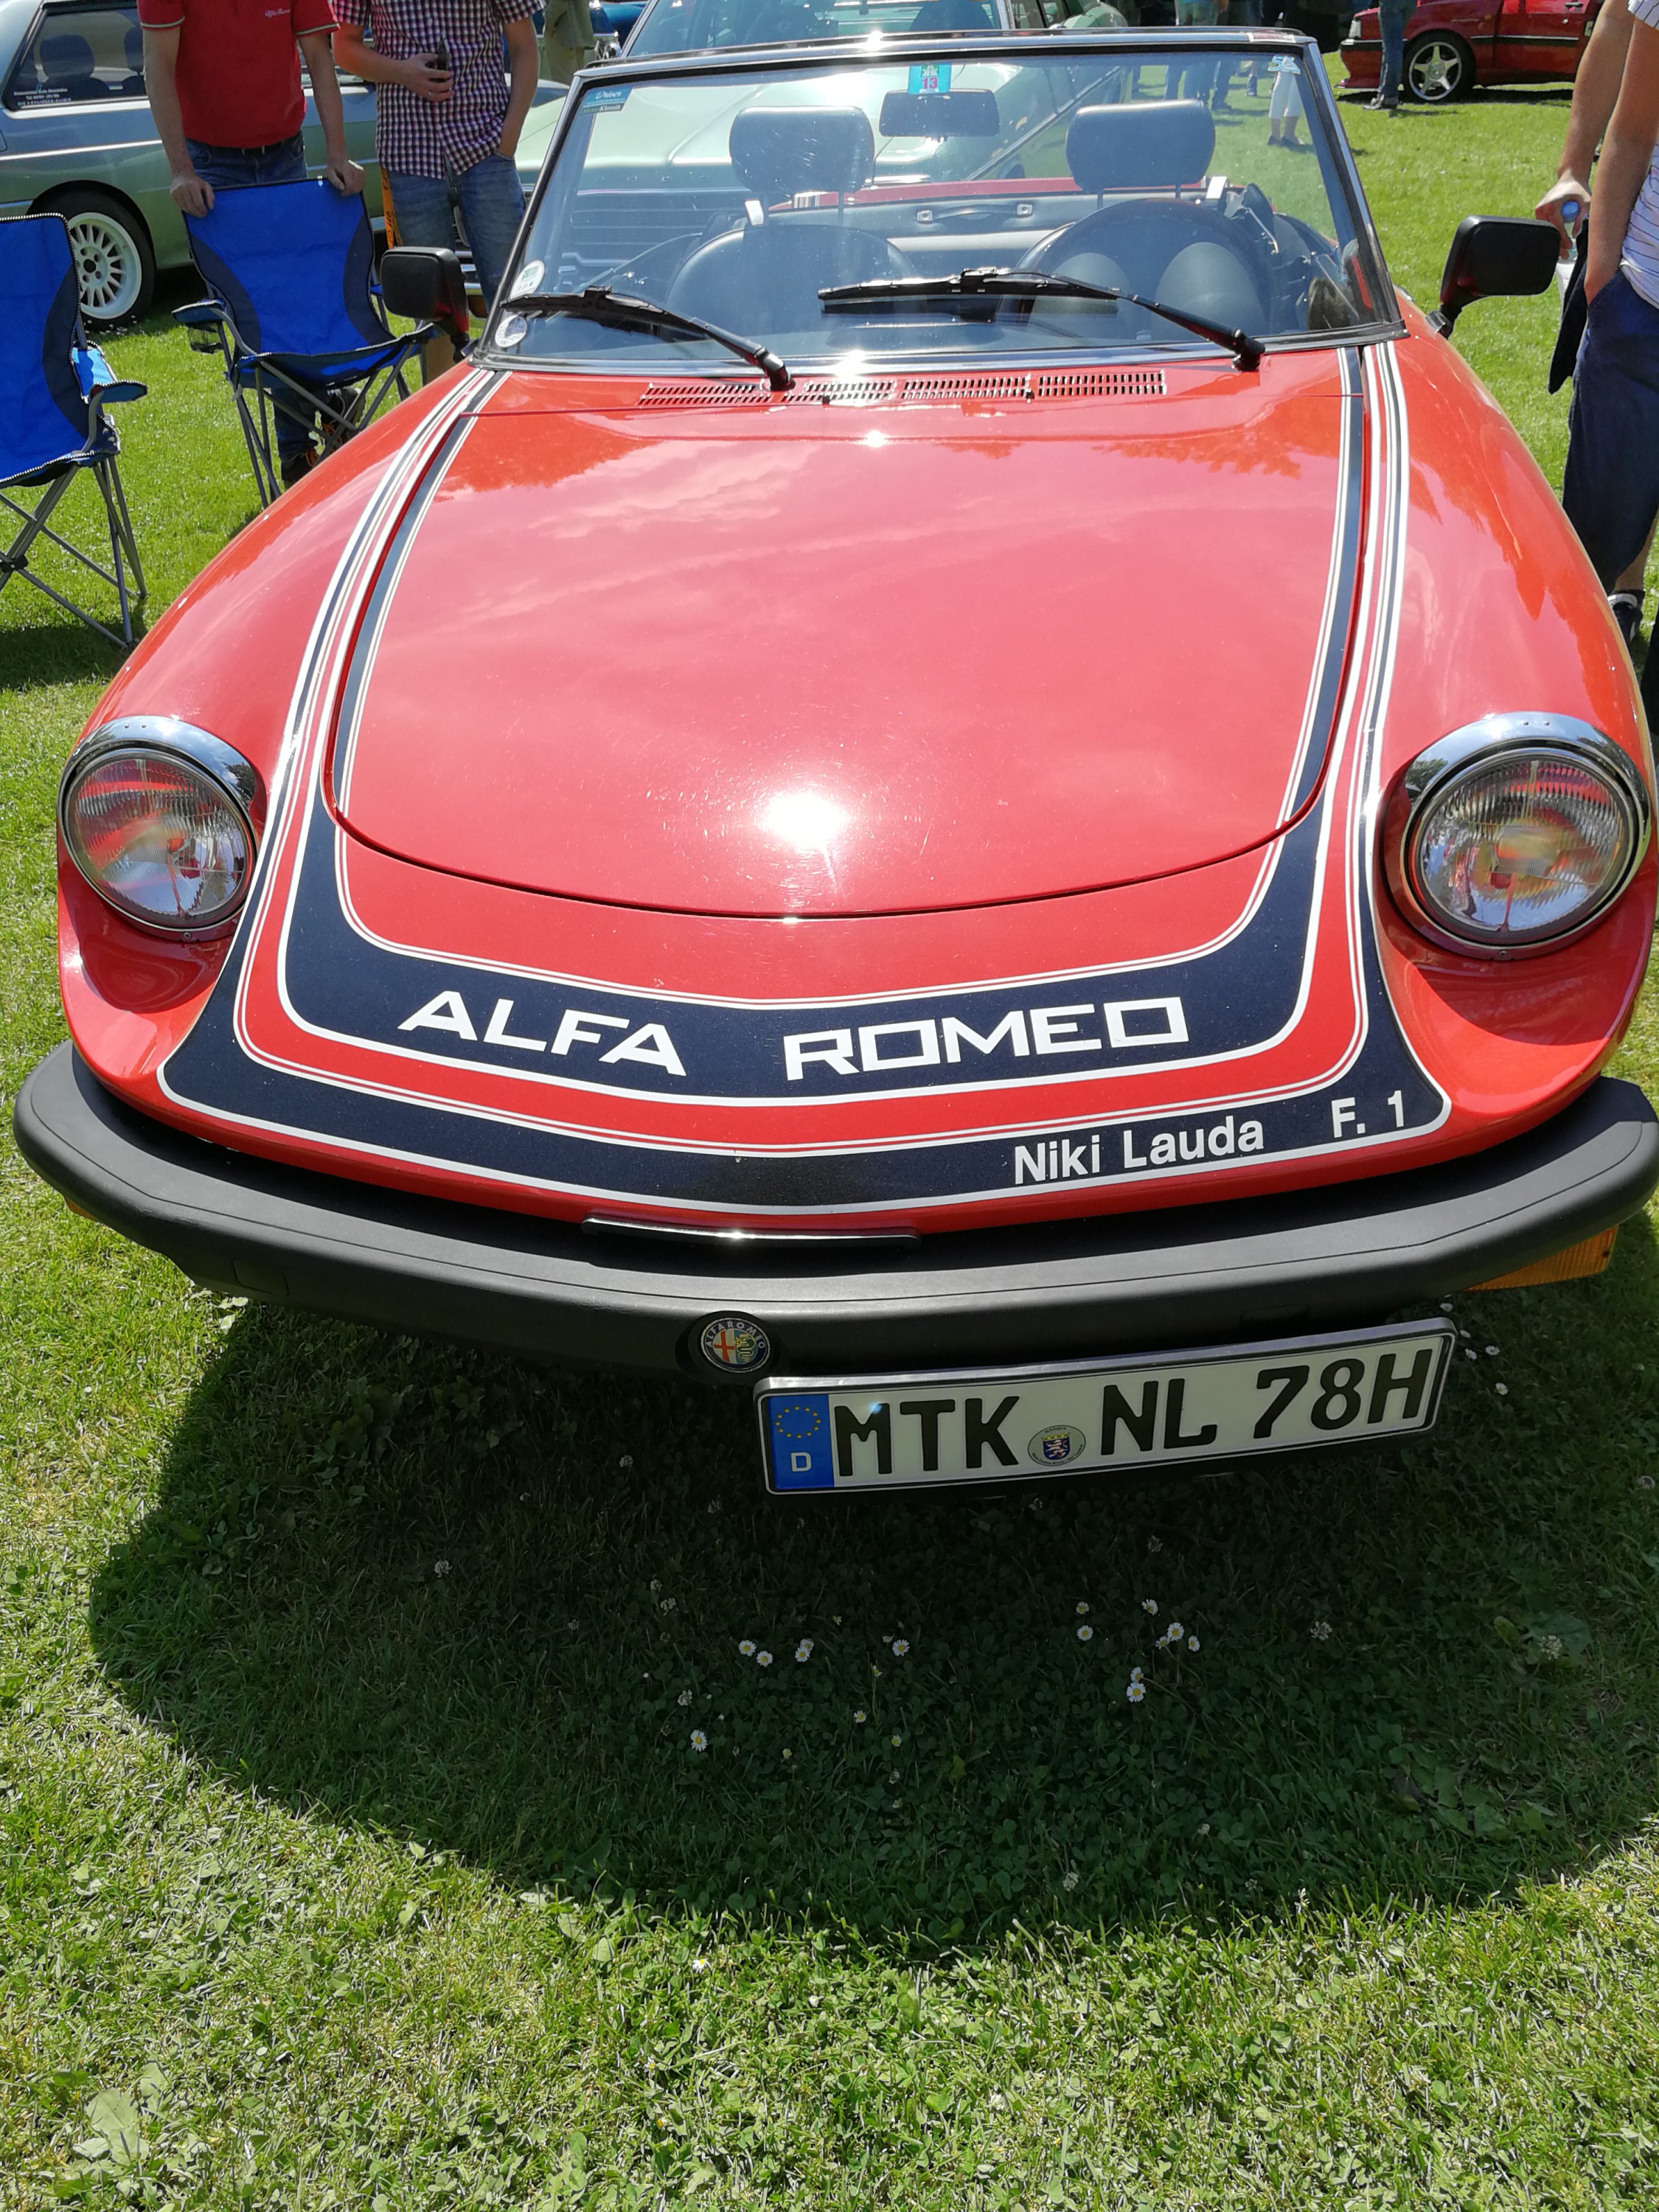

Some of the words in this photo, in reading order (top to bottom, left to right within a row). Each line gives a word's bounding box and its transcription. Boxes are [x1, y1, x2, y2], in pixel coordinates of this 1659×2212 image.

[922, 77, 938, 89] 13
[397, 991, 686, 1076] ALFA
[784, 997, 1189, 1080] ROMEO
[1015, 1135, 1100, 1184] Niki
[1123, 1116, 1264, 1169] Lauda
[1332, 1097, 1366, 1138] F.
[1388, 1091, 1404, 1127] 1
[834, 1396, 1020, 1476] MTK
[1101, 1378, 1217, 1455] NL
[1253, 1349, 1433, 1439] 78H
[790, 1452, 811, 1472] D
